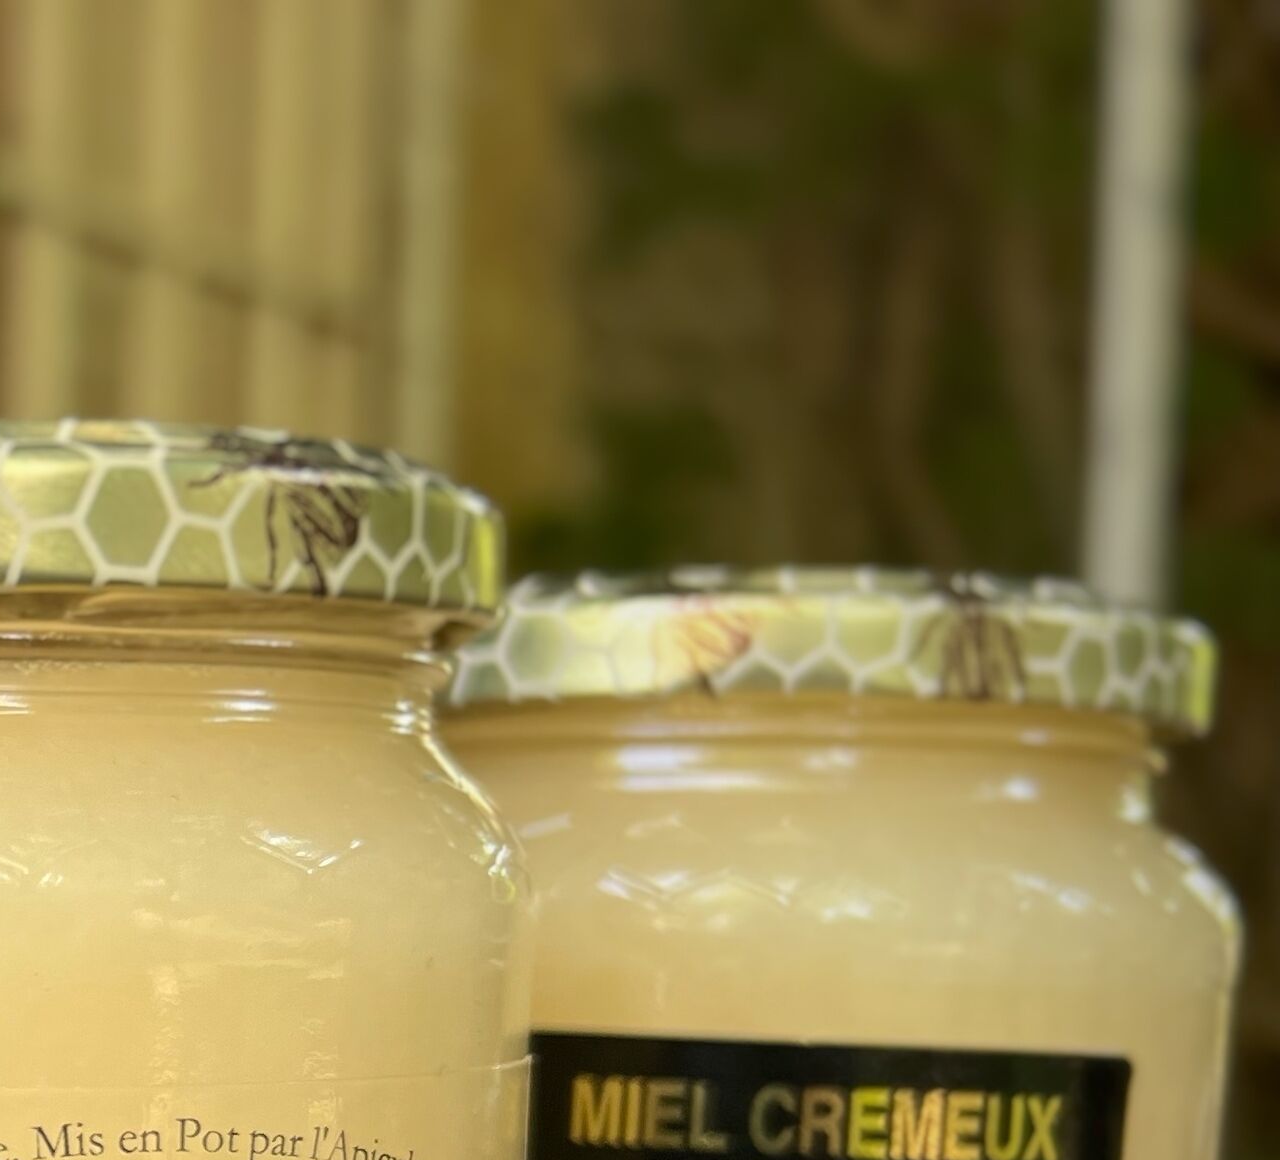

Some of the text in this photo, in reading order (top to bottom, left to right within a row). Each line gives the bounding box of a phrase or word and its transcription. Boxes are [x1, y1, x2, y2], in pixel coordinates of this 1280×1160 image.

[30, 1121, 105, 1160] Mis
[118, 1126, 163, 1154] en
[175, 1118, 240, 1153] Pot
[567, 1073, 728, 1153] MIEL
